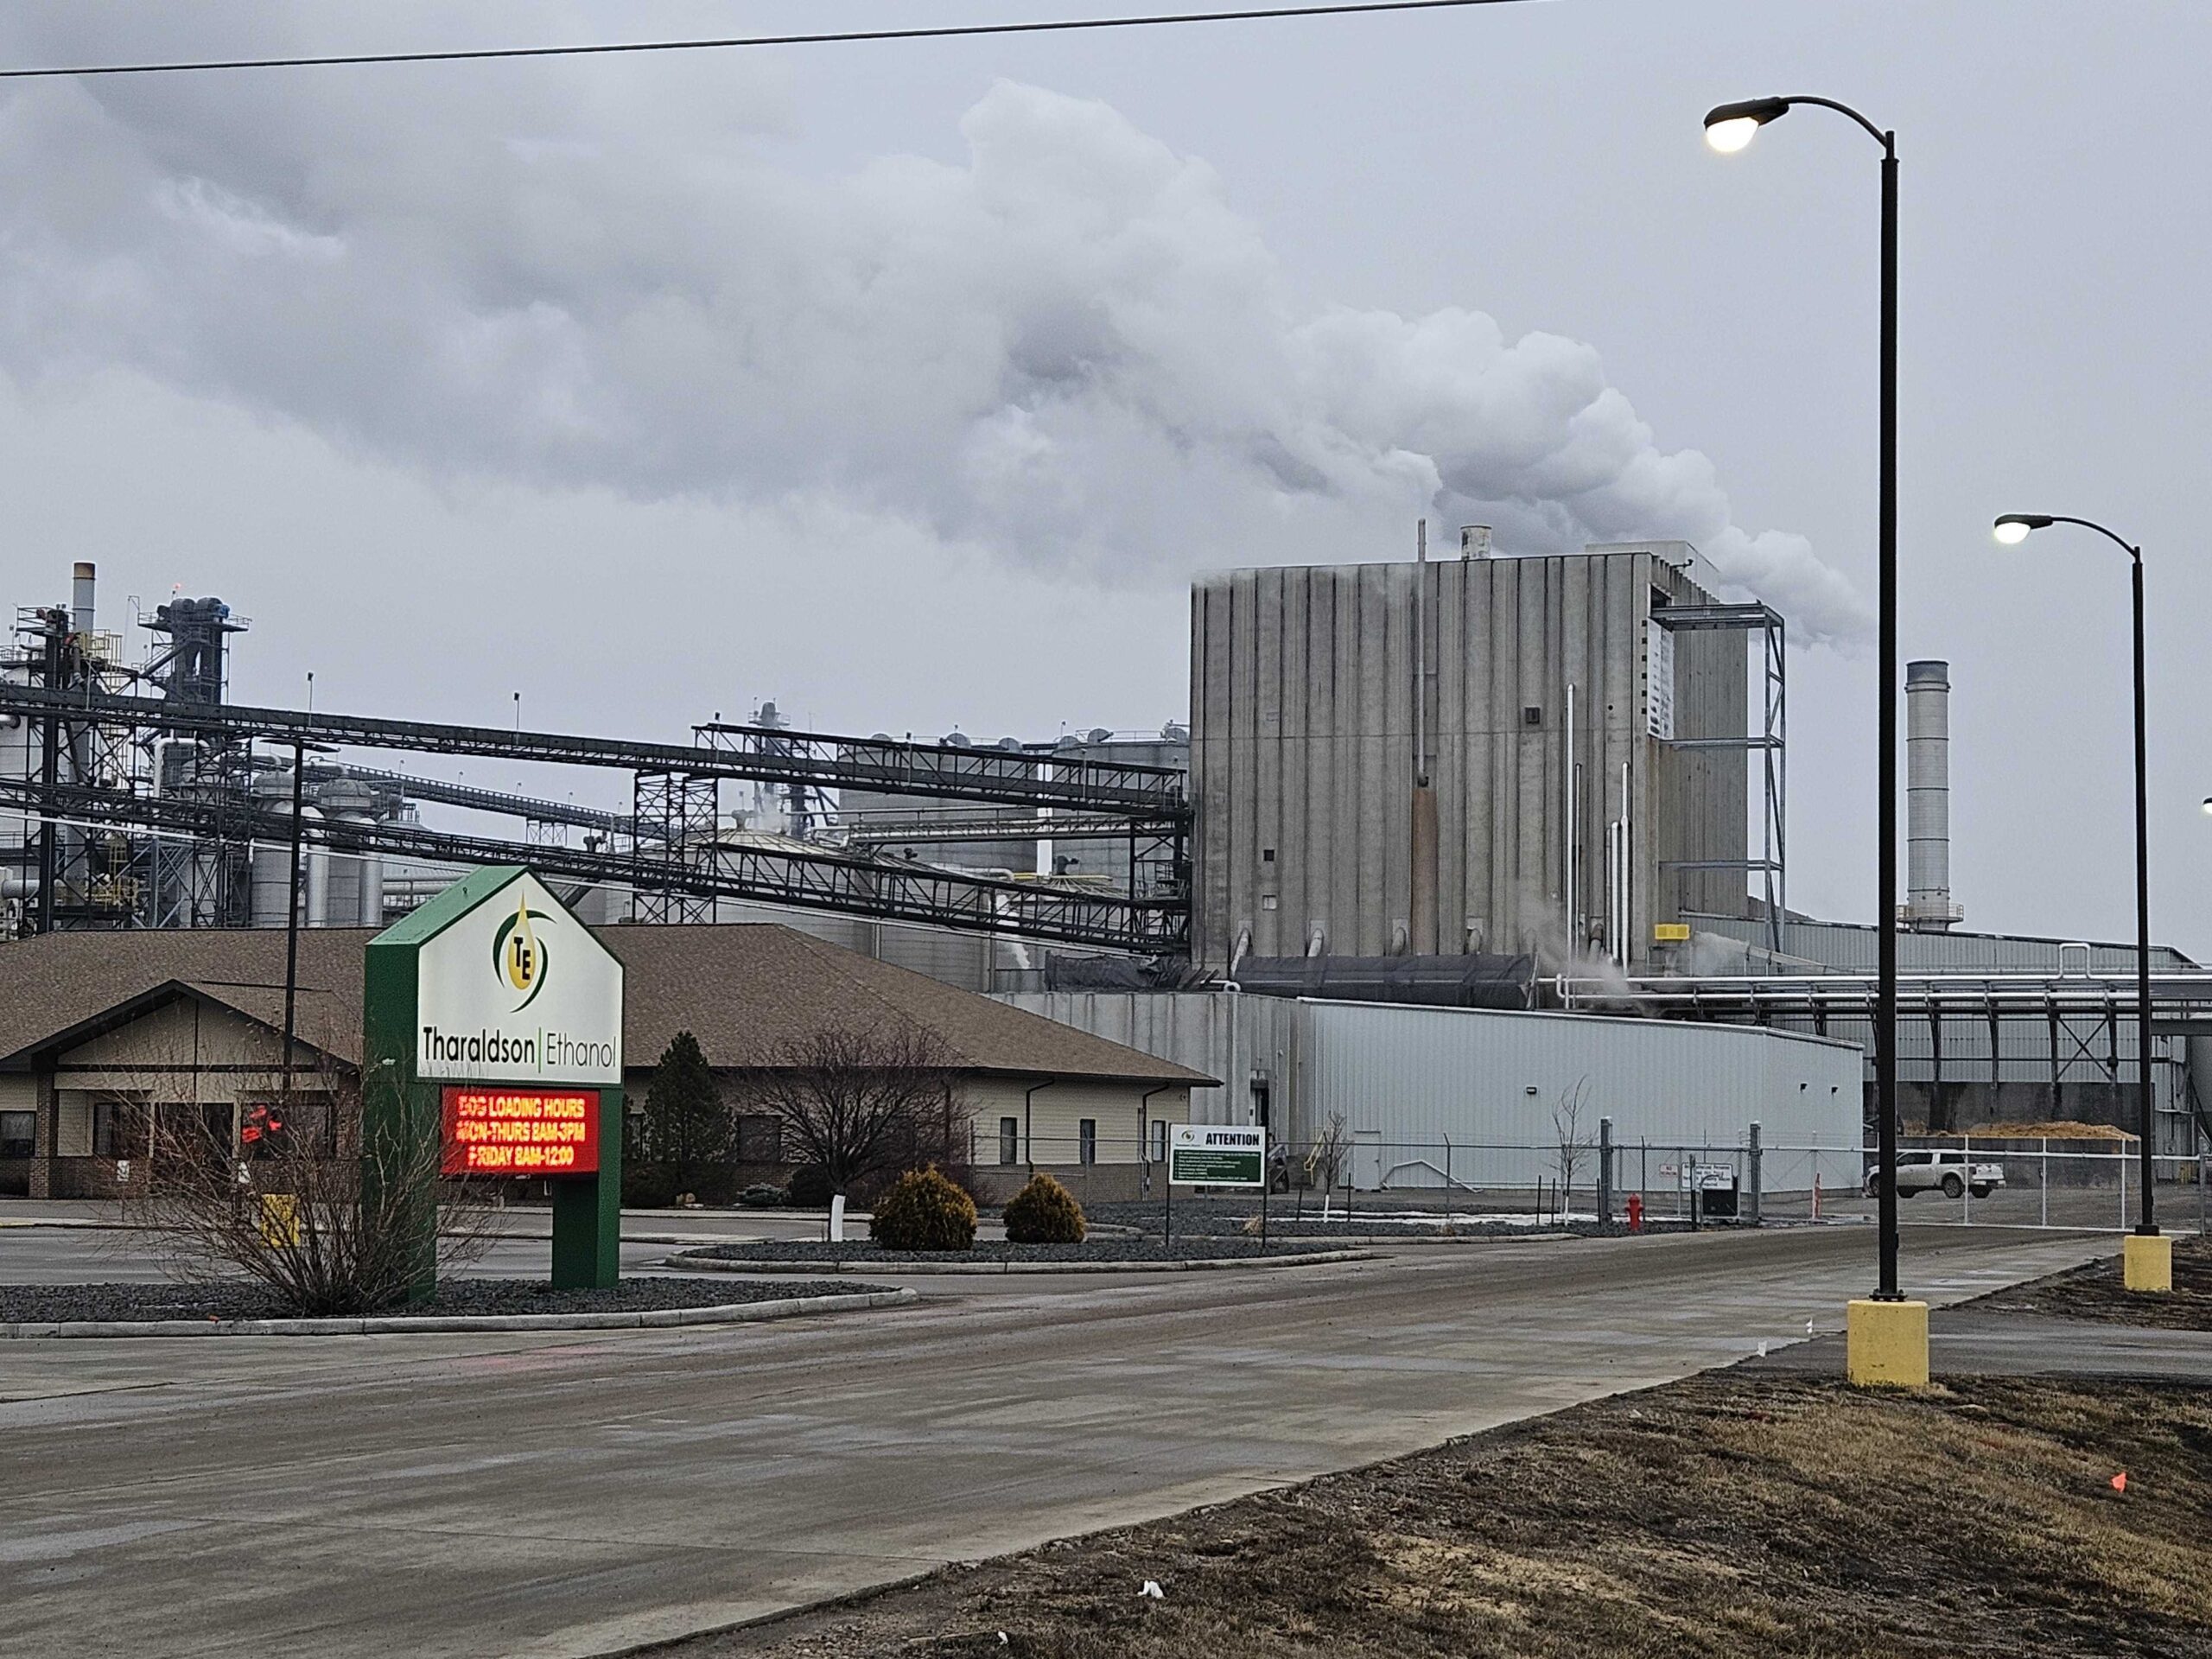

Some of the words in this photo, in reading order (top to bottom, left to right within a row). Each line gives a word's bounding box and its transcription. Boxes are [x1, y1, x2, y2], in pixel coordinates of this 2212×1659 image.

[423, 1026, 535, 1064] Tharaldson
[547, 1033, 616, 1067] Ethanol
[488, 1096, 542, 1117] LOADING
[543, 1098, 585, 1118] HOURS
[456, 1121, 531, 1142] MON-THURS
[531, 1122, 586, 1142] 8AM-3PM
[1205, 1133, 1260, 1146] ATTENTION
[467, 1145, 513, 1166] FRIDAY
